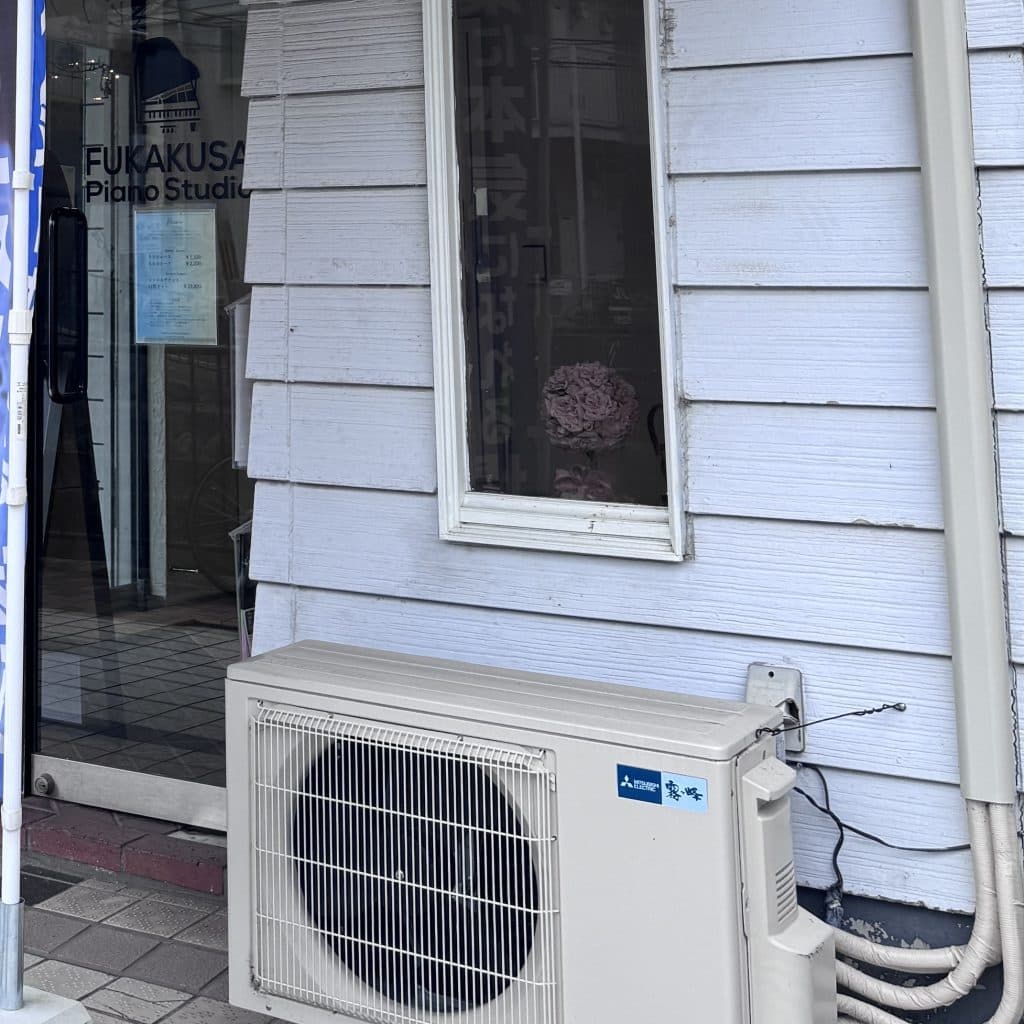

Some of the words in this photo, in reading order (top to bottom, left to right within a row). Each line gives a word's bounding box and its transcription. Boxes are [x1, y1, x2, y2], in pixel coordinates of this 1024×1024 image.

[86, 140, 245, 176] FUKAKUSA
[86, 179, 159, 203] Piano
[165, 176, 251, 201] Studio
